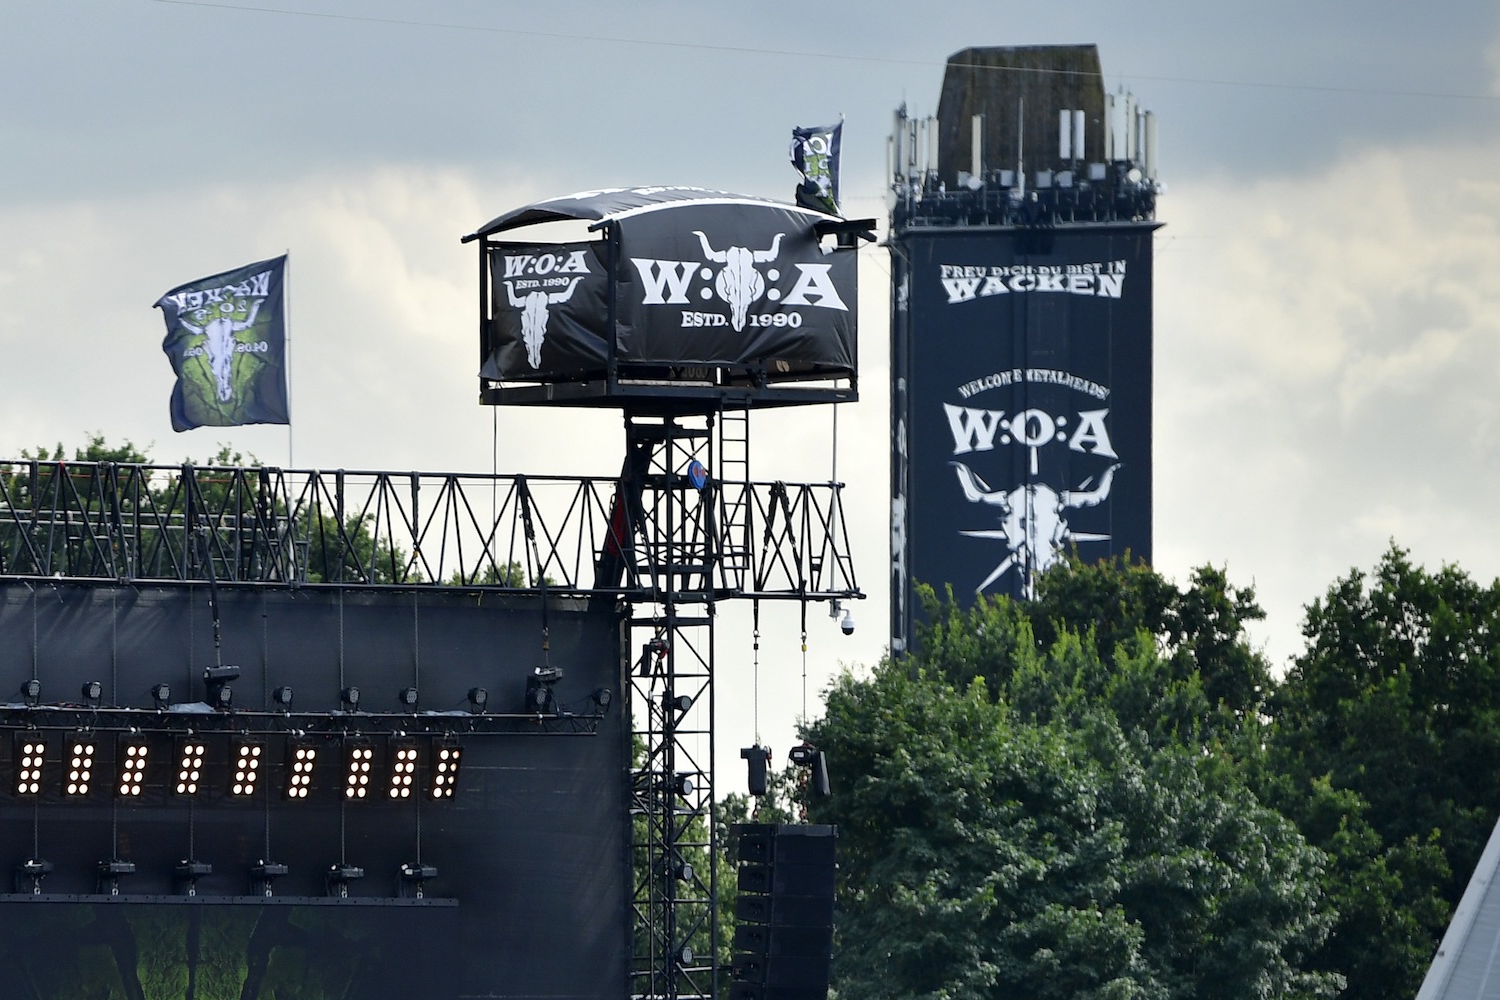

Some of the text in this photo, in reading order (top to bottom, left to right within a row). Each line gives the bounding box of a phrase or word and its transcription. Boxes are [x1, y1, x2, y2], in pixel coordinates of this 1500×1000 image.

[940, 265, 987, 278] FREU
[1037, 265, 1062, 275] DU
[1066, 262, 1103, 275] BIST
[1107, 259, 1128, 275] IN
[542, 276, 570, 288] 1990
[940, 273, 1126, 305] WACKEN
[680, 310, 802, 329] ESTD. 1990
[957, 368, 1023, 400] WELCOME
[942, 402, 1119, 459] W:O:A
